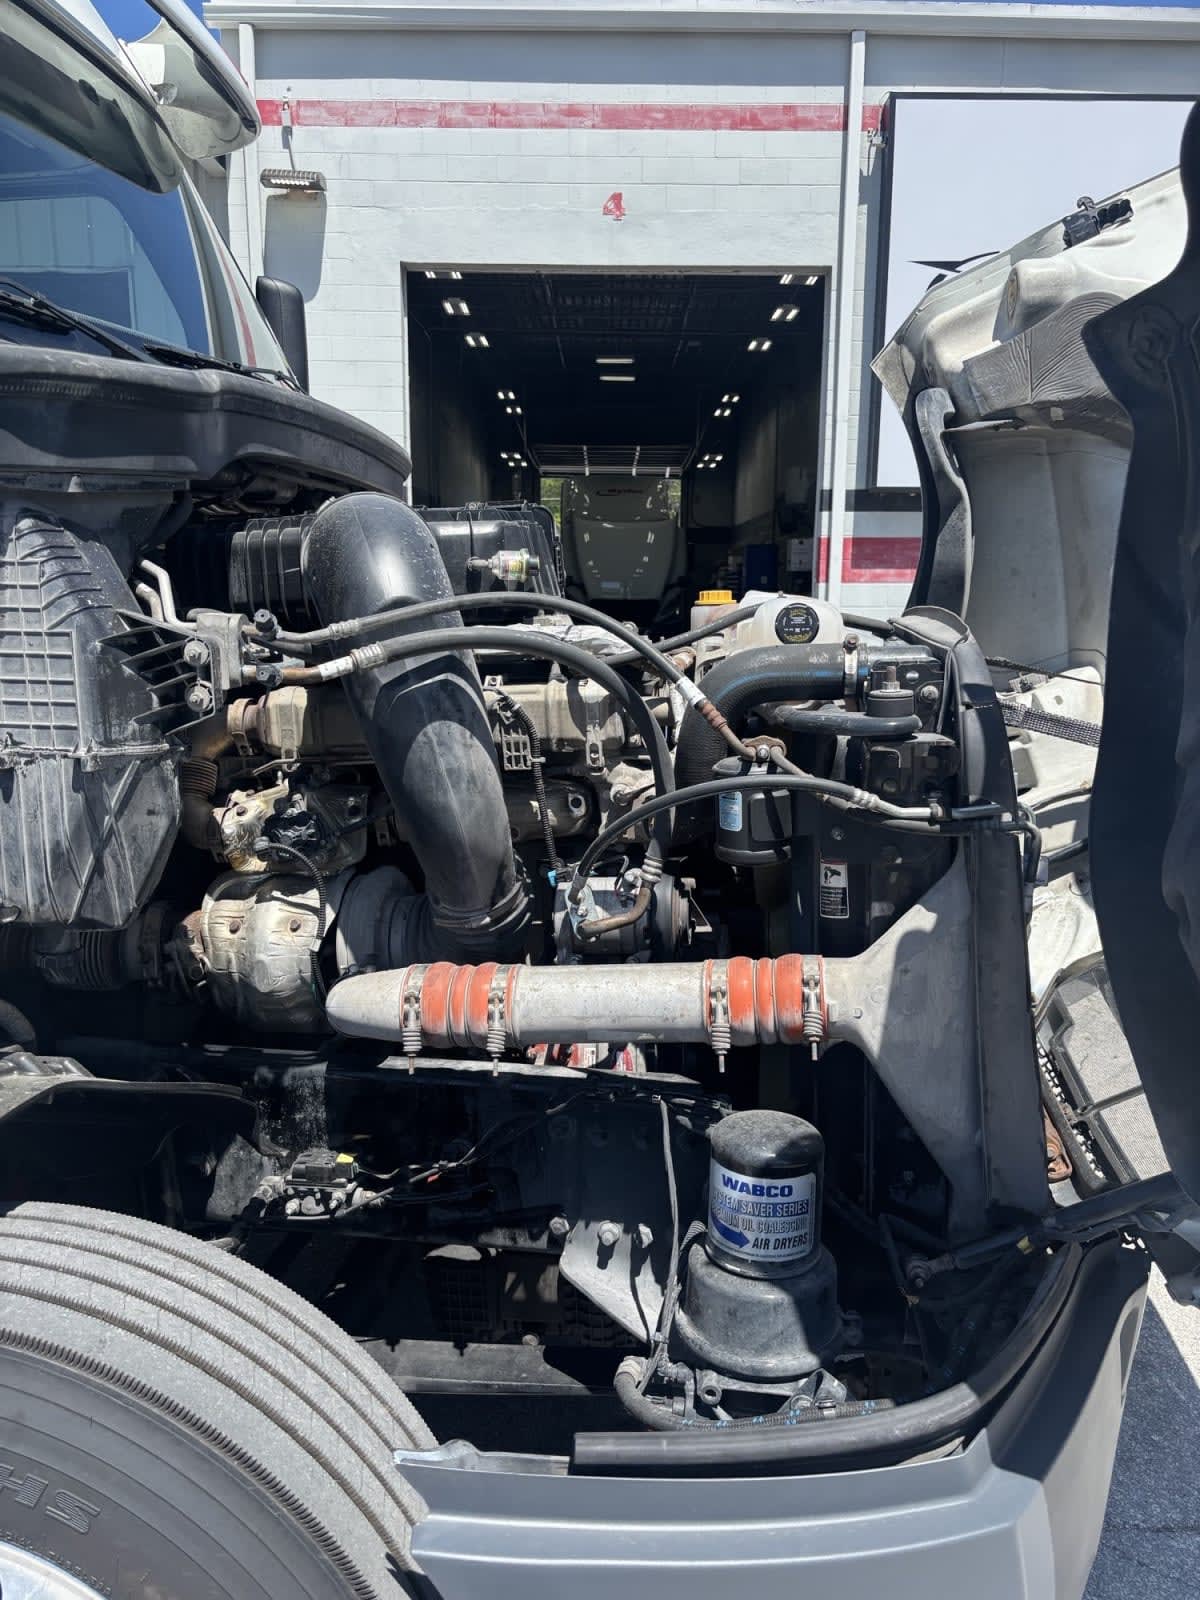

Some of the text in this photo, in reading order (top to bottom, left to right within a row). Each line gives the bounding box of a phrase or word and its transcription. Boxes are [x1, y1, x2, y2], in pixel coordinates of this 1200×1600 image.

[602, 191, 626, 221] 4
[722, 1174, 794, 1198] WABCO
[741, 1199, 773, 1217] SAVER
[776, 1200, 808, 1217] SERIES
[741, 1216, 754, 1232] OIL
[752, 1232, 808, 1250] AIR DRYERS
